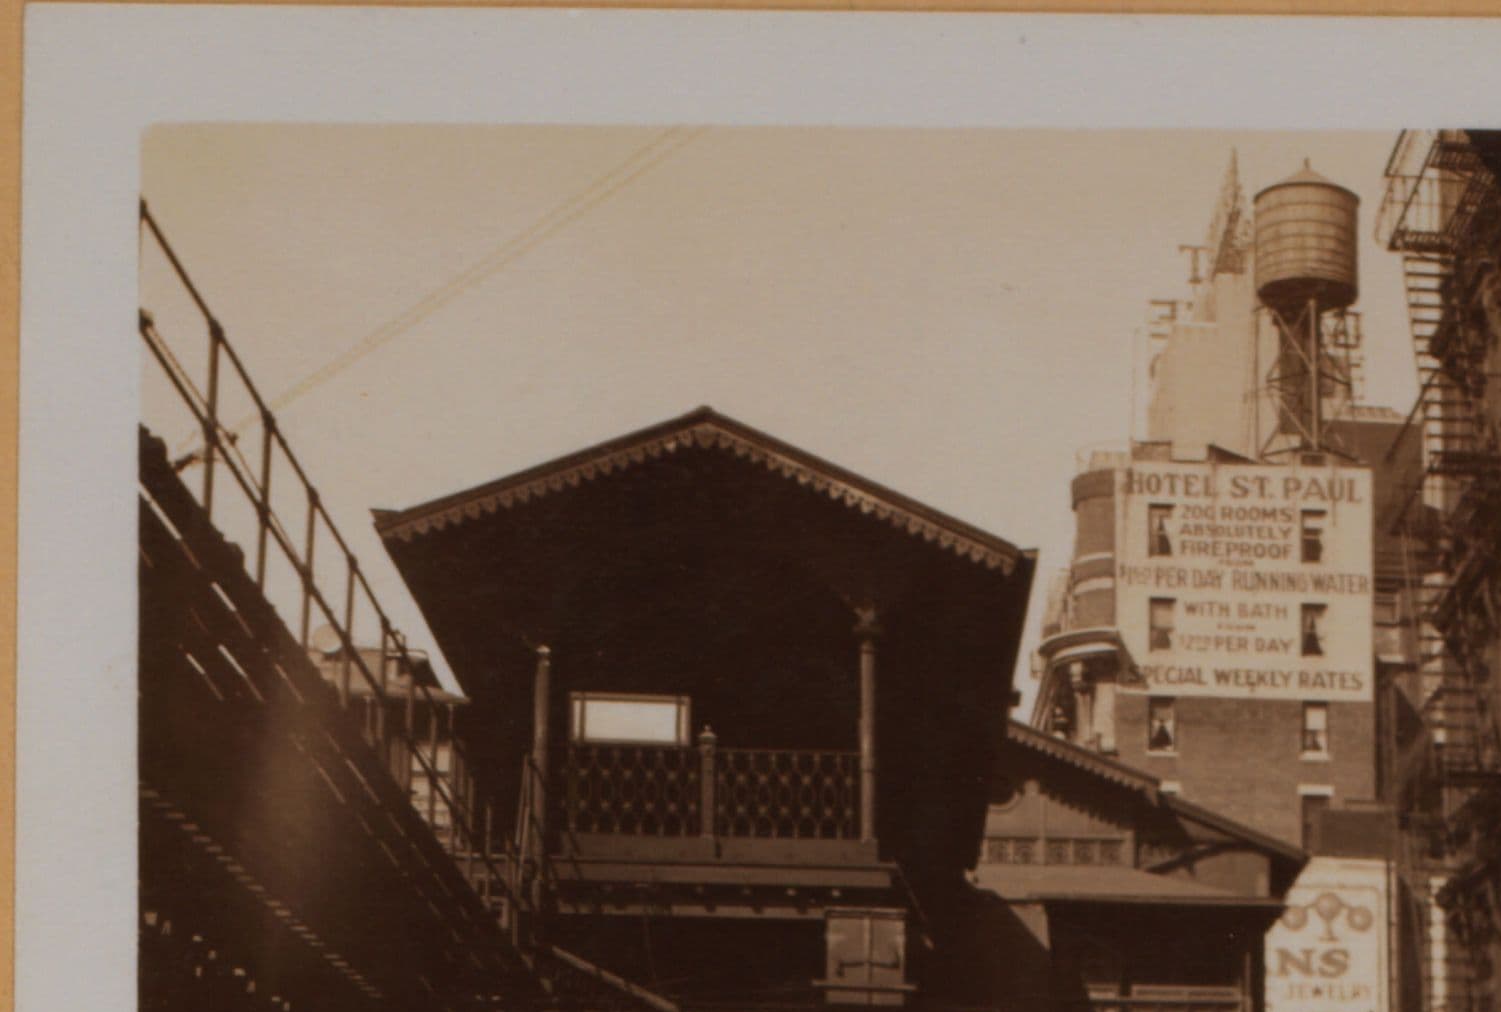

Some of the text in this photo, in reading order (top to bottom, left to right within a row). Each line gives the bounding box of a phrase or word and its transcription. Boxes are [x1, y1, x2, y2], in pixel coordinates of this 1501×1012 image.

[1124, 471, 1362, 504] HOTEL ST. PAUL
[1220, 505, 1293, 522] ROOMS
[1179, 523, 1293, 540] ABSOLUTELY
[1179, 539, 1293, 559] FIREPROOF
[1155, 565, 1188, 588] PER
[1192, 568, 1225, 590] DAY
[1232, 569, 1308, 593] RUNNING
[1311, 573, 1369, 594] WATER
[1183, 601, 1288, 620] WITH BATH
[1214, 634, 1248, 653] PER
[1255, 636, 1296, 655] DAY
[1213, 667, 1293, 688] WEEKLY
[1300, 670, 1364, 691] RATES
